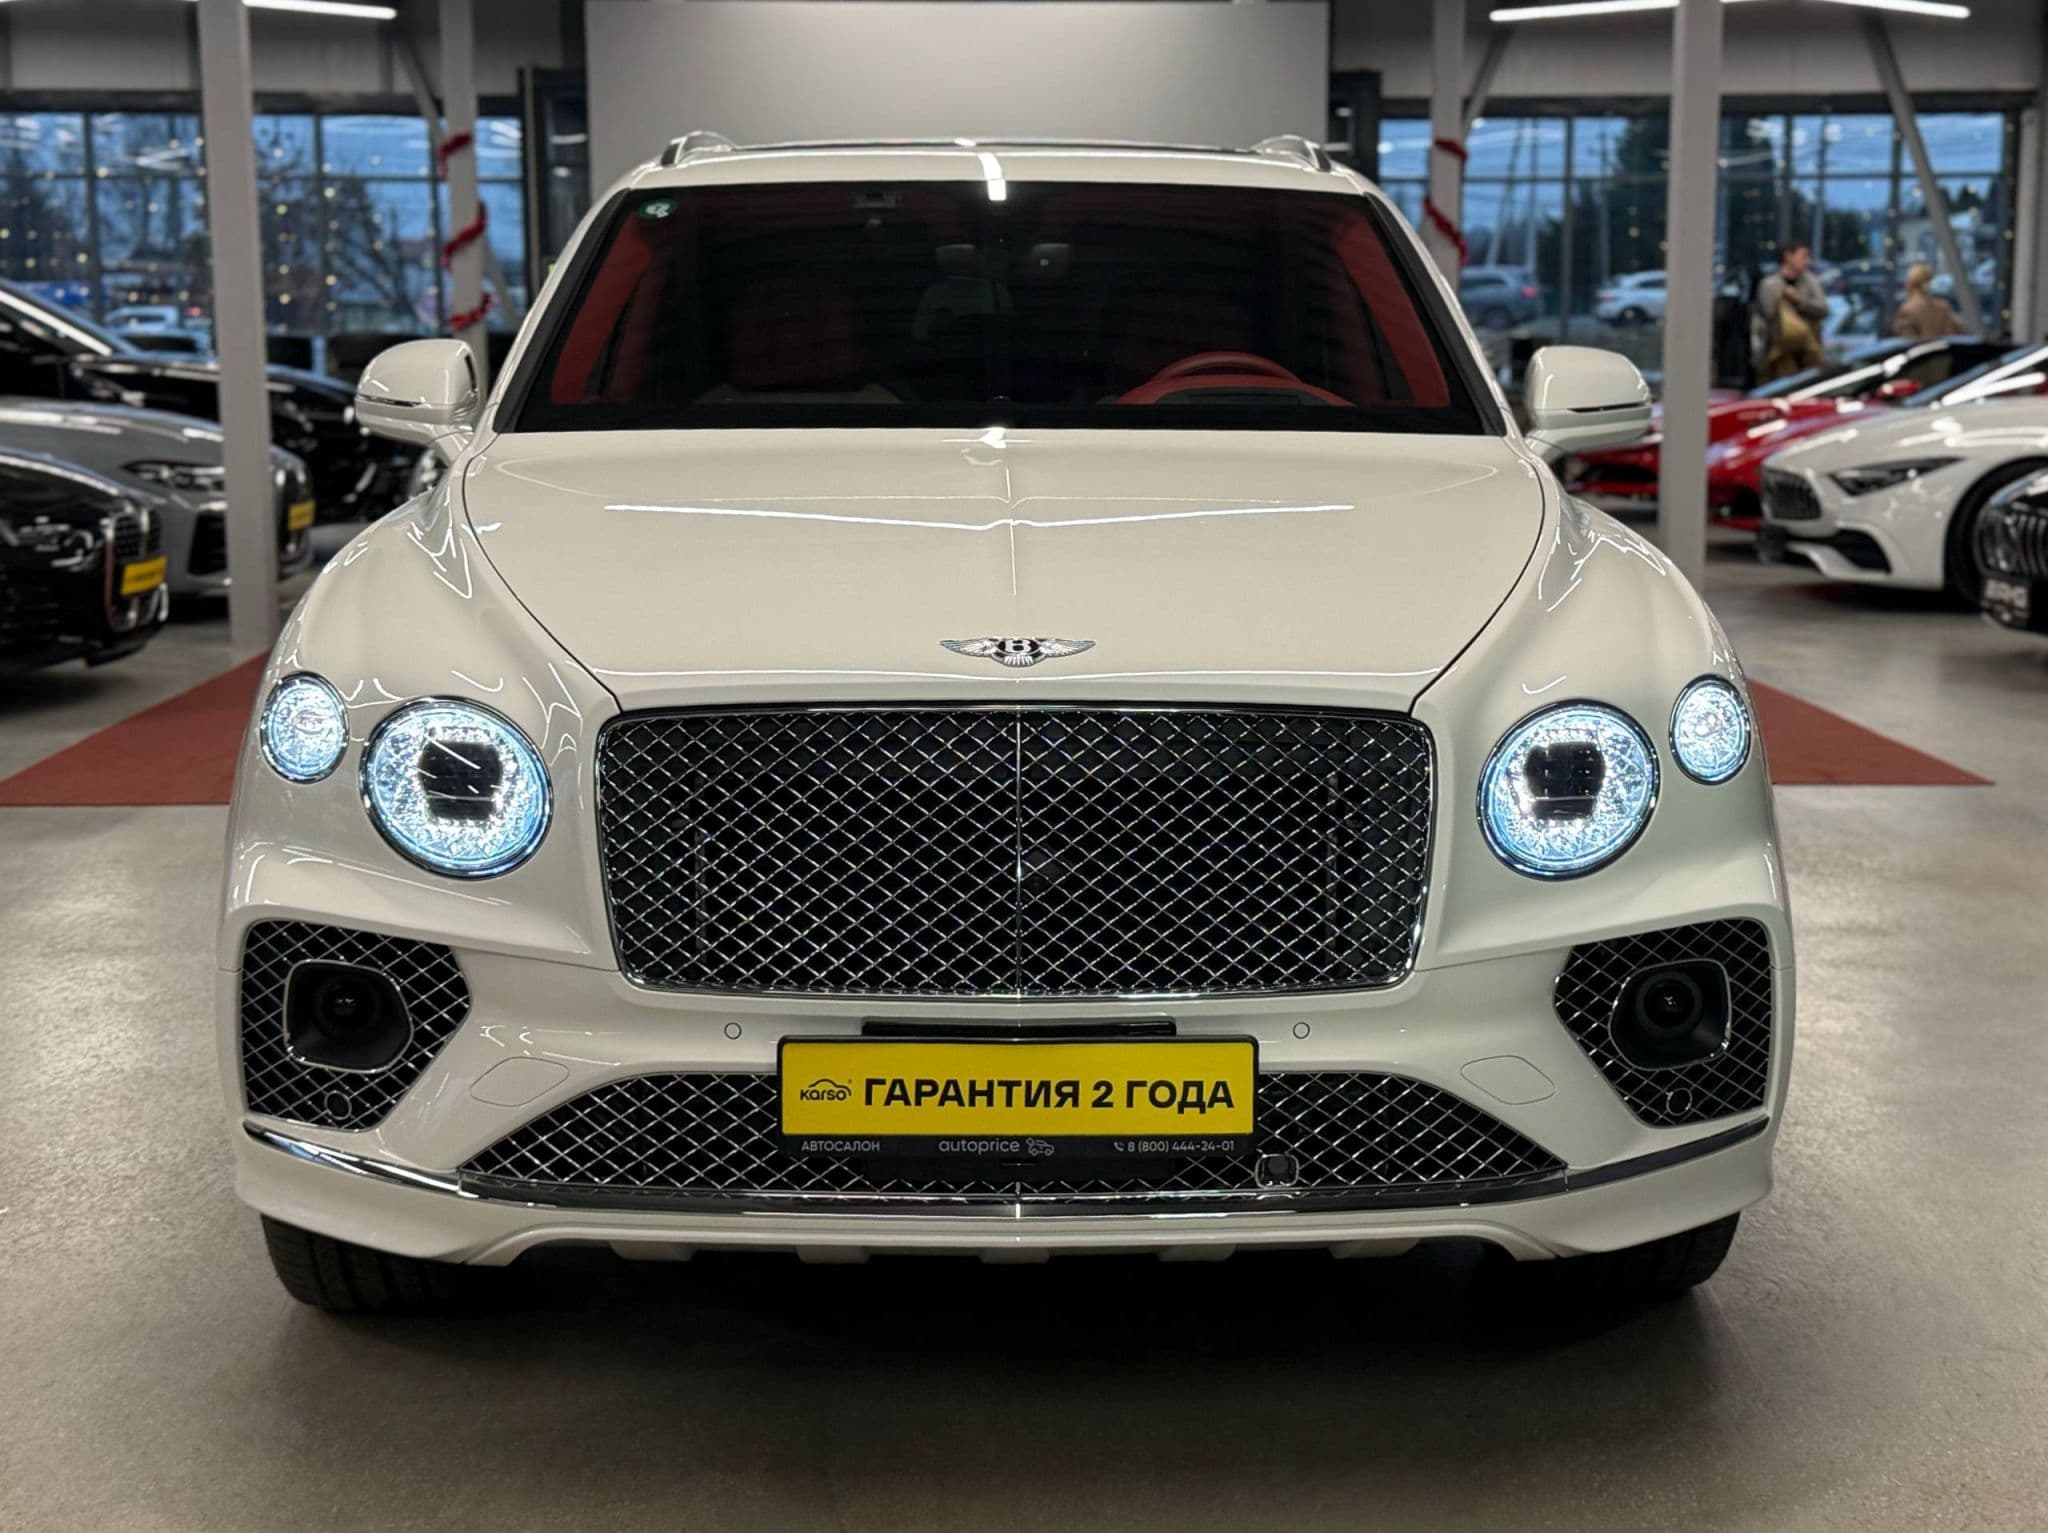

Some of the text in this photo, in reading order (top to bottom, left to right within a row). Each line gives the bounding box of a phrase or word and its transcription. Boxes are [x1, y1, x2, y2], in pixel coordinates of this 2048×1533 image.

[1005, 639, 1032, 654] B
[864, 1078, 1235, 1115] ГАРАНТИЯ 2 ГОДА
[801, 1140, 880, 1152] АВТОСАЛОН
[938, 1138, 1020, 1155] autoprice
[1127, 1140, 1235, 1153] 8 (800) 444-24-01
